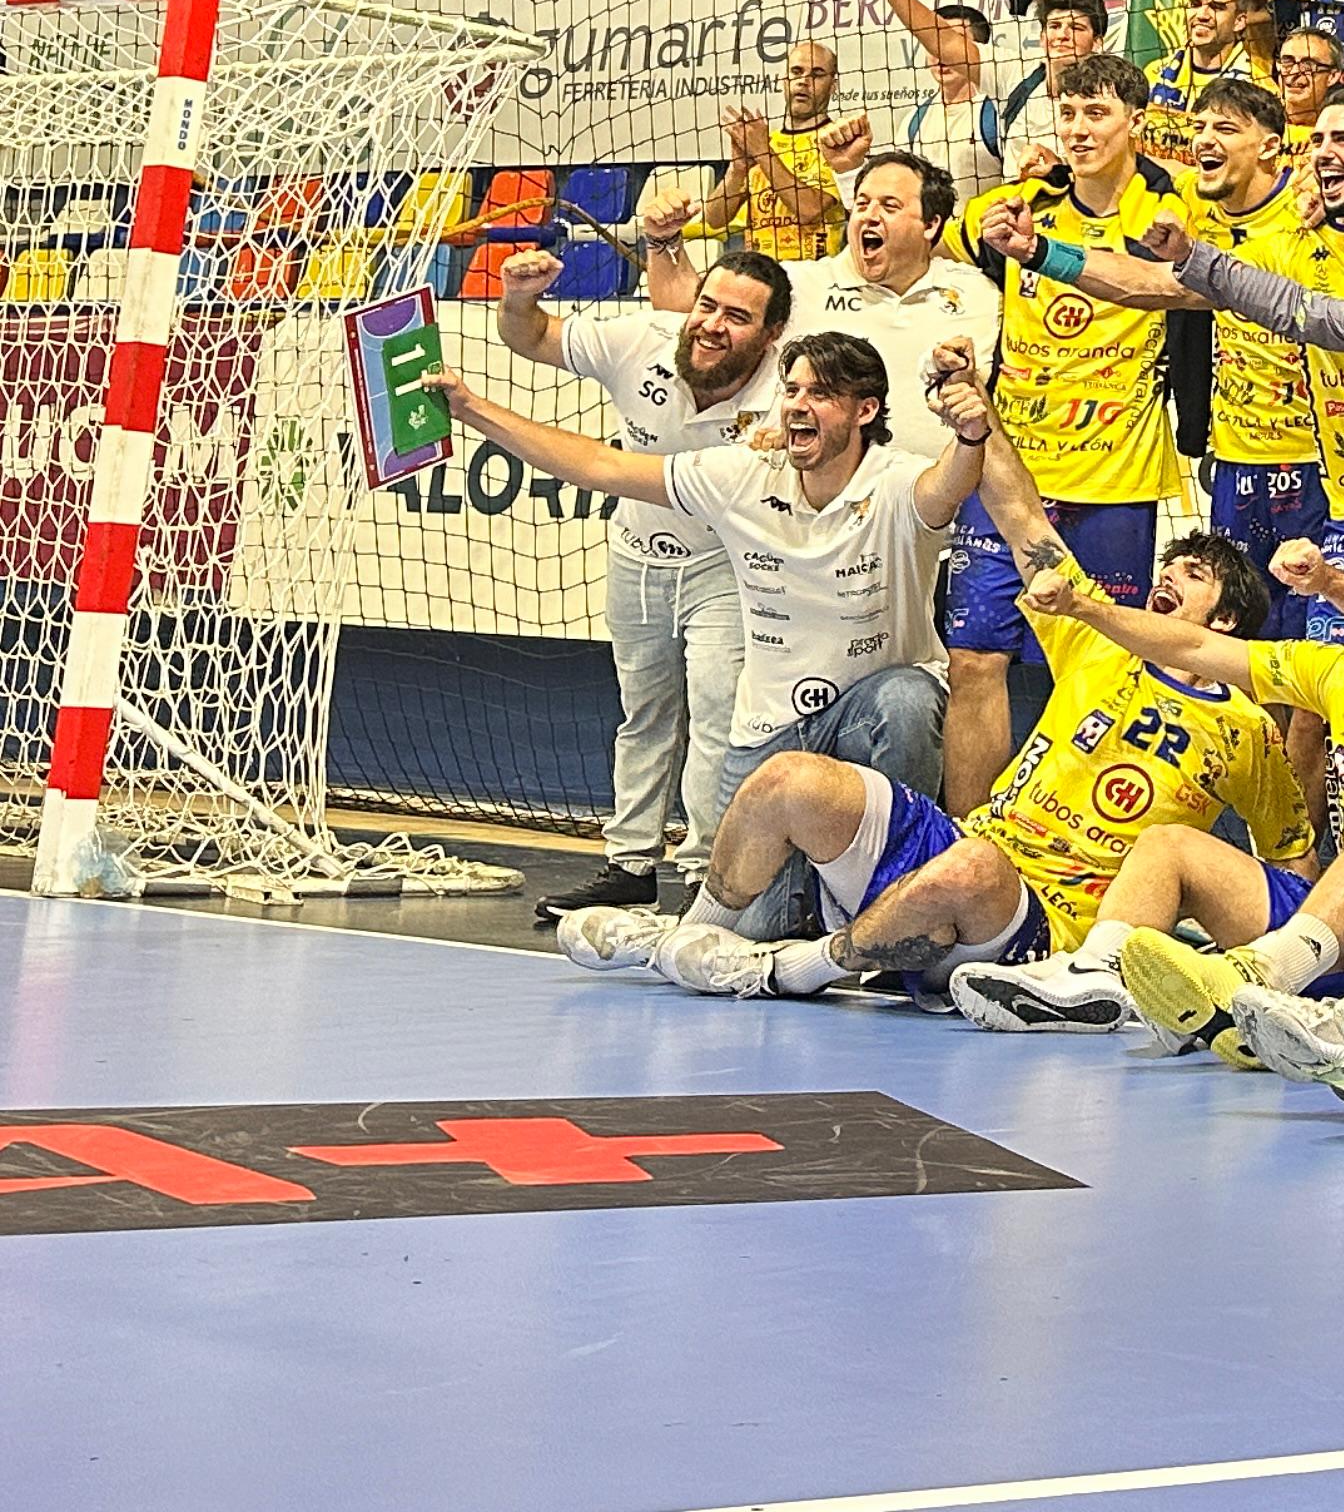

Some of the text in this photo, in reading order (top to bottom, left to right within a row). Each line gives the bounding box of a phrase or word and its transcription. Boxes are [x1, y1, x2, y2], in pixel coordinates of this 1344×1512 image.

[673, 71, 784, 98] INDUSTRIAL
[177, 97, 195, 152] MONDO
[824, 295, 862, 314] MC
[1057, 341, 1137, 360] aranda
[637, 378, 668, 406] SG
[1122, 706, 1191, 769] 22
[1030, 780, 1085, 831] tubos
